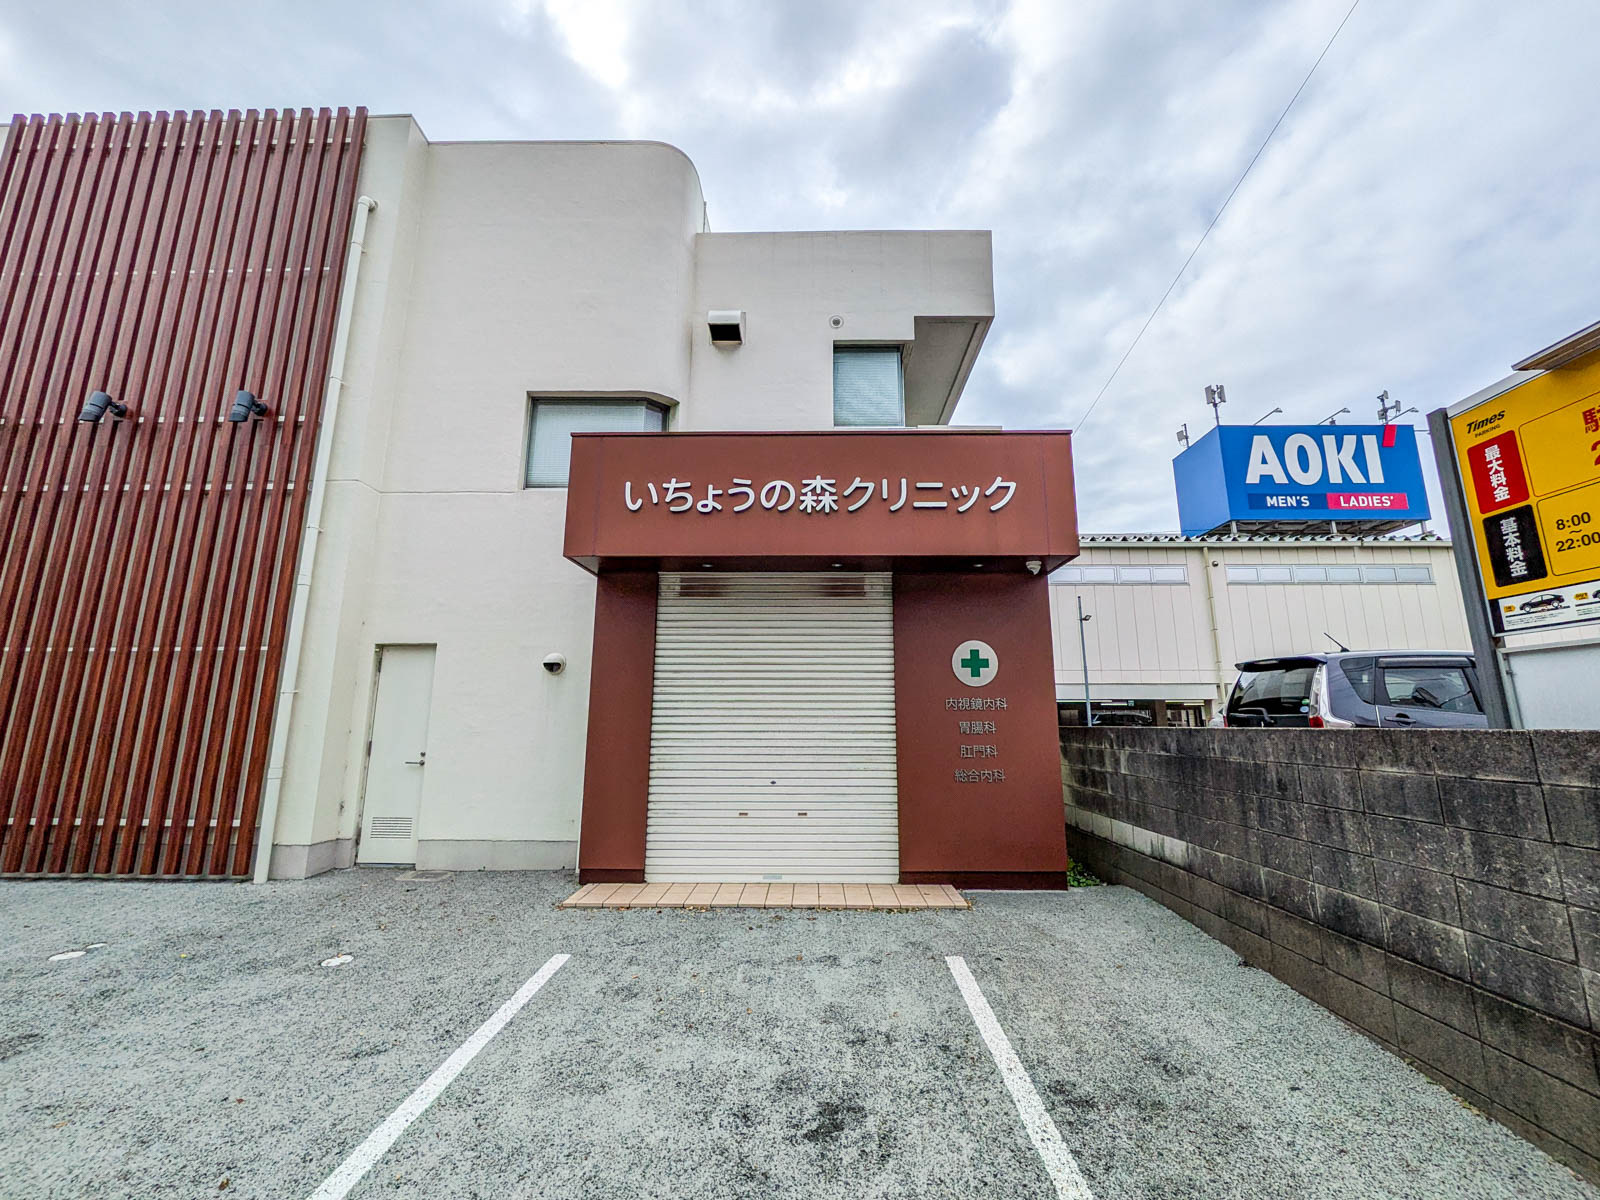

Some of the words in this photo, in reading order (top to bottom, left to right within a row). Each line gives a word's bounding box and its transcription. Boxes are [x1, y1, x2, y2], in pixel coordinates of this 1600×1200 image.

[1466, 410, 1505, 434] Times
[1245, 433, 1385, 485] AOKI
[1484, 444, 1511, 503] 最大料金
[625, 475, 1017, 514] いちょうの森クリニック
[1266, 495, 1310, 507] MEN'S
[1556, 512, 1591, 530] 8:00
[1500, 516, 1528, 578] 基本料金
[1556, 532, 1600, 552] 22:00
[945, 697, 1008, 711] 内視鏡内科
[959, 721, 997, 734] 胃腸科
[960, 744, 998, 758] 肛門科
[954, 769, 1006, 783] 総合内科
